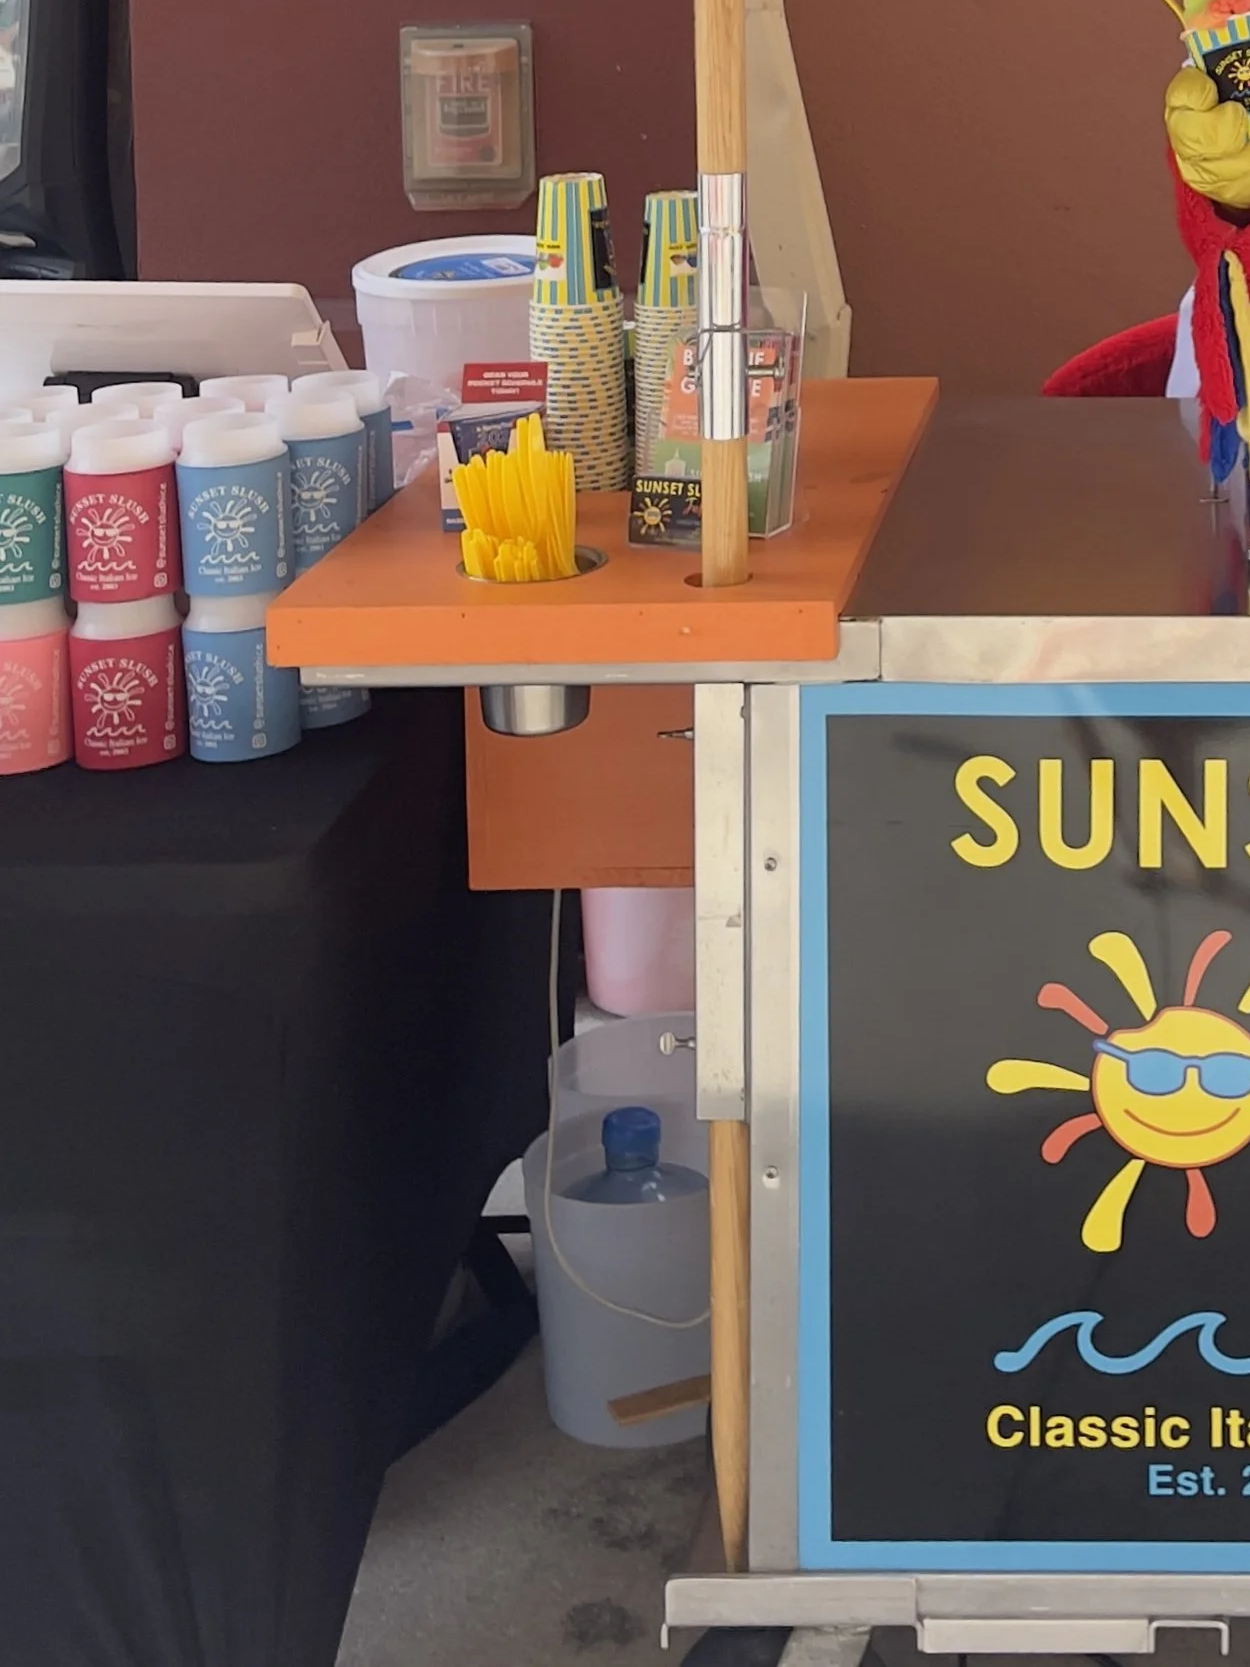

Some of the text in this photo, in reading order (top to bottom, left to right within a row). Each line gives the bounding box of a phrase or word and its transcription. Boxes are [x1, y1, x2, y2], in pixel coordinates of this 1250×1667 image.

[436, 70, 491, 94] FIRE
[635, 479, 683, 497] SUNSET
[7, 493, 47, 526] SLUSH
[109, 493, 150, 525] SLUSH
[119, 657, 159, 688] SLUSH
[986, 1405, 1191, 1450] Classic
[1147, 1463, 1228, 1497] Est.
